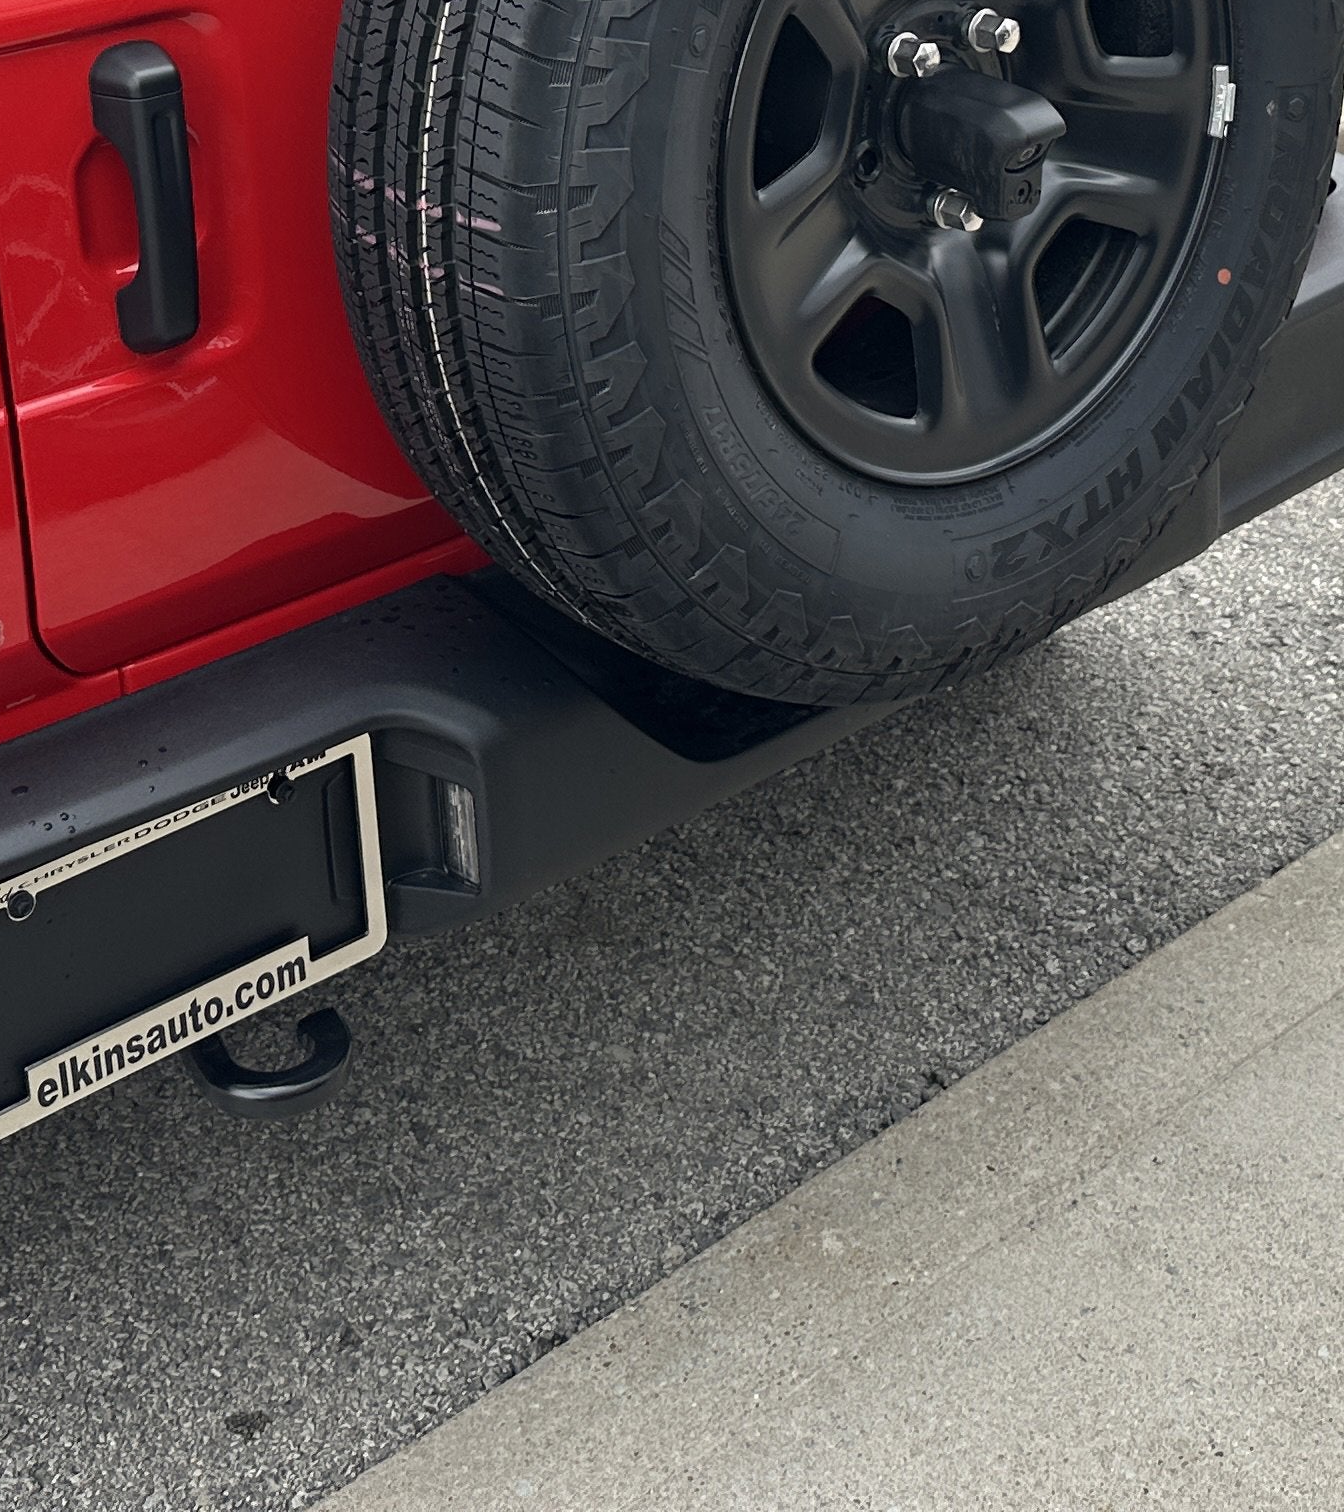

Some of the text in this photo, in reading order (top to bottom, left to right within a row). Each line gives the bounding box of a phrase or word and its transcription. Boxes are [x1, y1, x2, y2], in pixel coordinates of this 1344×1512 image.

[988, 443, 1152, 584] HTX2
[17, 837, 130, 888] CHRYSLER
[133, 793, 227, 840] DODGE
[230, 774, 269, 799] Jeep
[37, 955, 307, 1108] elkinsauto.com
